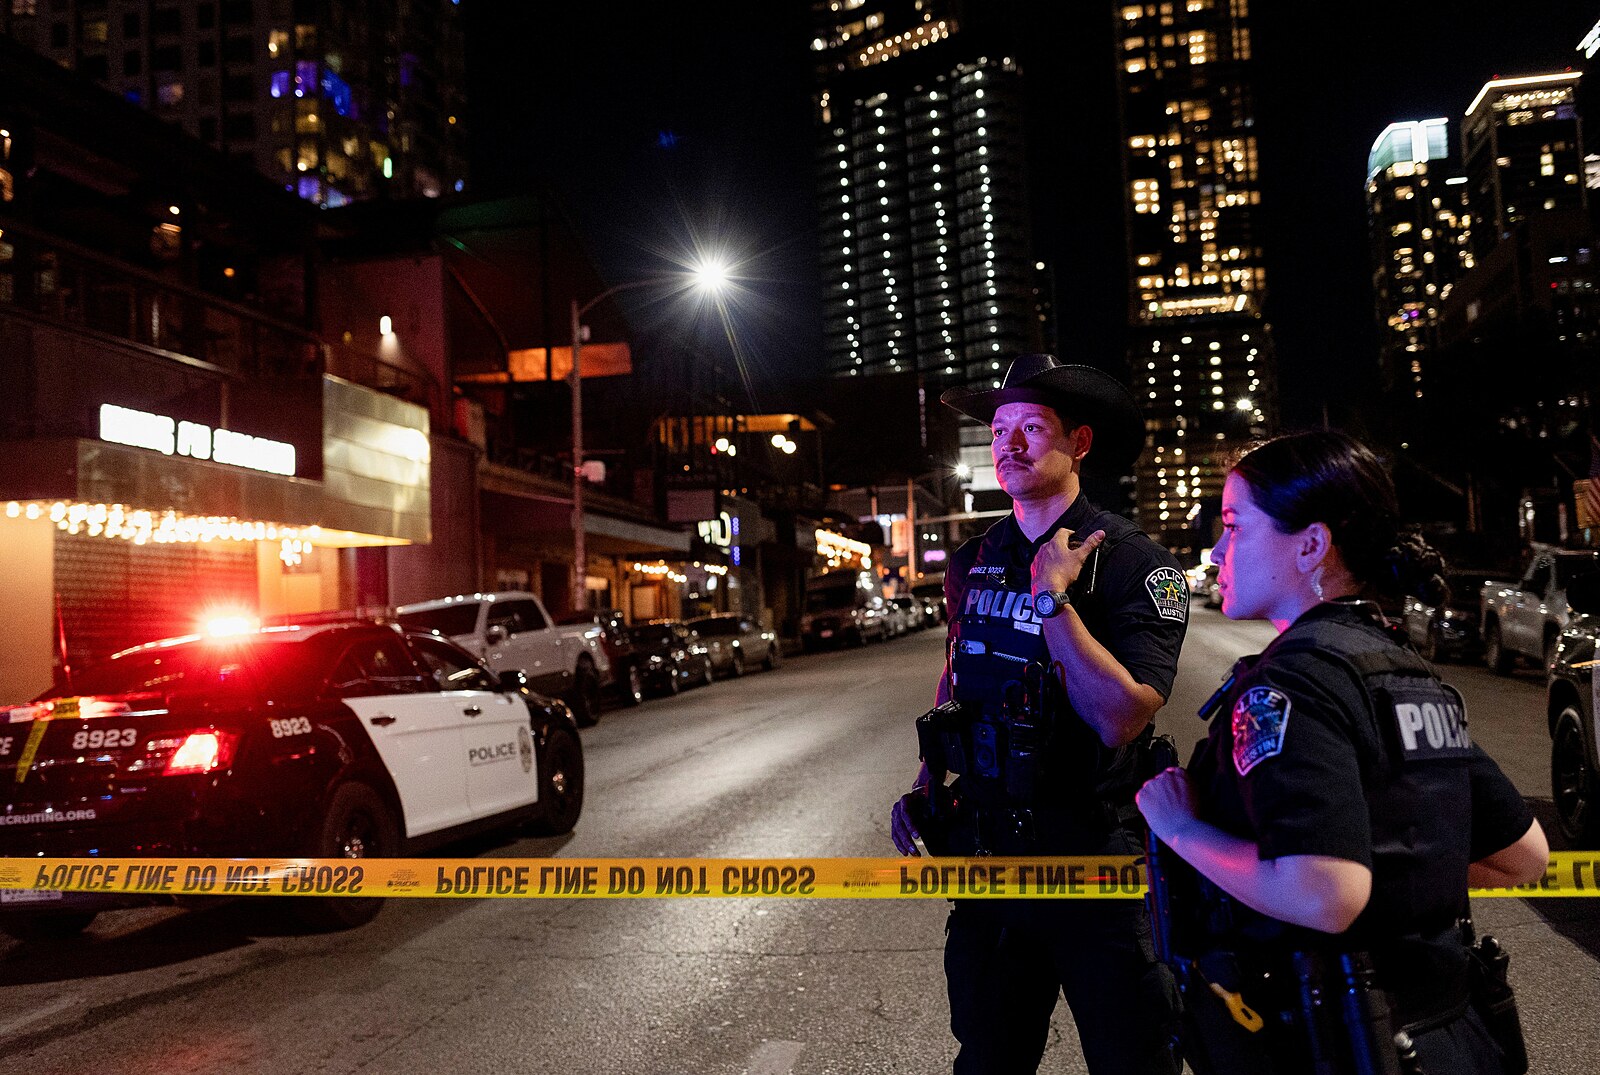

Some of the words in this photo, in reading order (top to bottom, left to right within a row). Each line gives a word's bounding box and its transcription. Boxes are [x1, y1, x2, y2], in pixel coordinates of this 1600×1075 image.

[271, 716, 312, 738] 8923
[72, 728, 137, 750] 8923
[469, 742, 517, 762] POLICE
